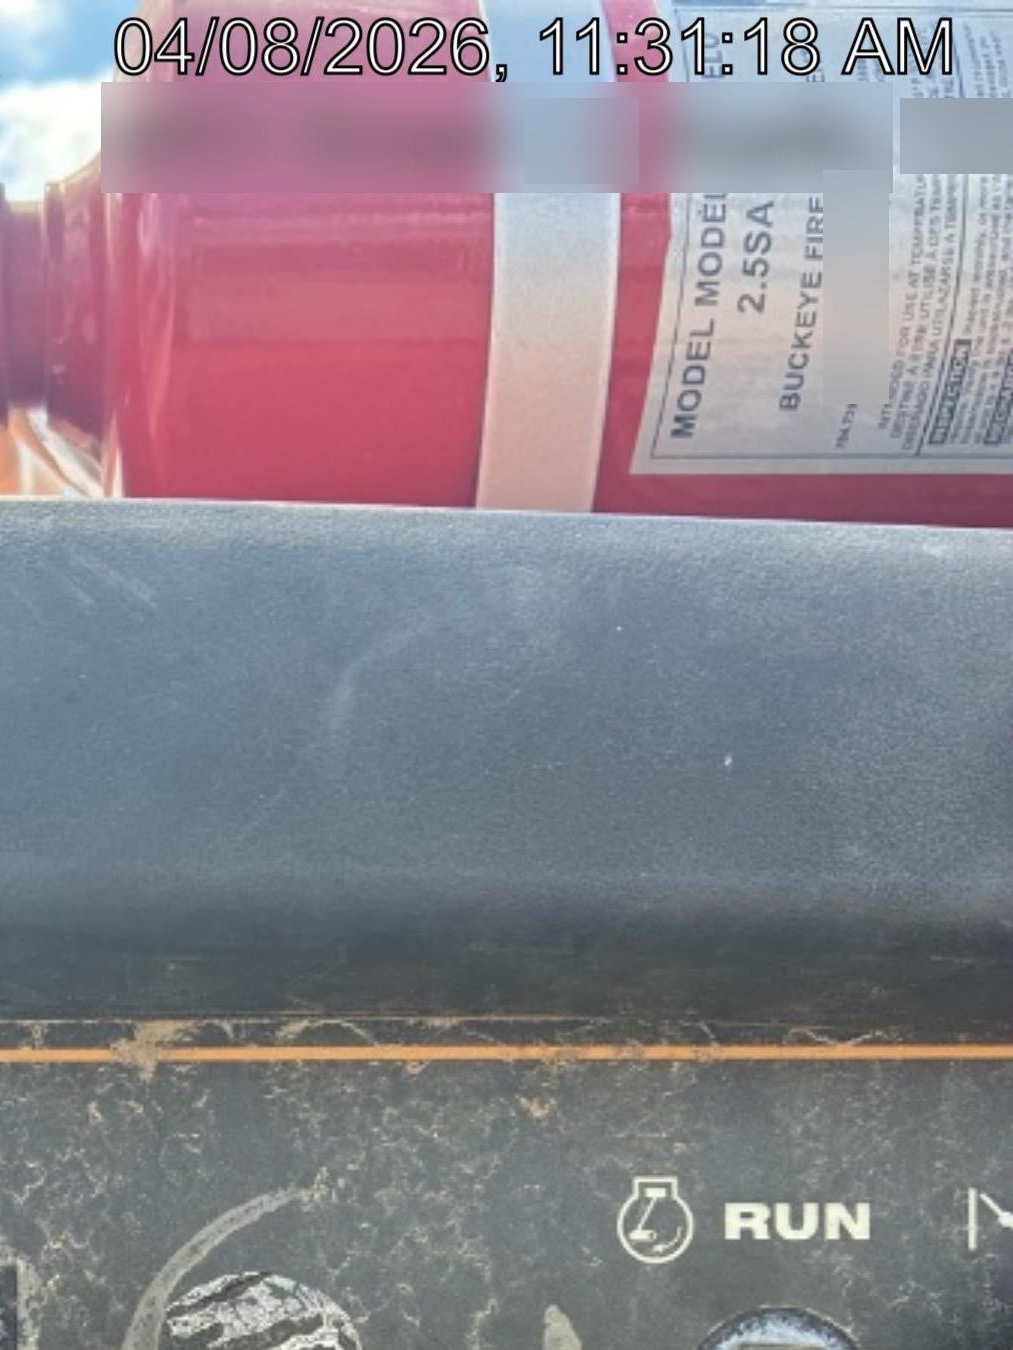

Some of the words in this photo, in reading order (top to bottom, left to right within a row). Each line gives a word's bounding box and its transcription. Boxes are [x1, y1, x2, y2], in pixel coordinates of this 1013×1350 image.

[671, 317, 714, 438] MODEL
[779, 270, 822, 409] BUCKEYE
[723, 1202, 871, 1240] RUN
